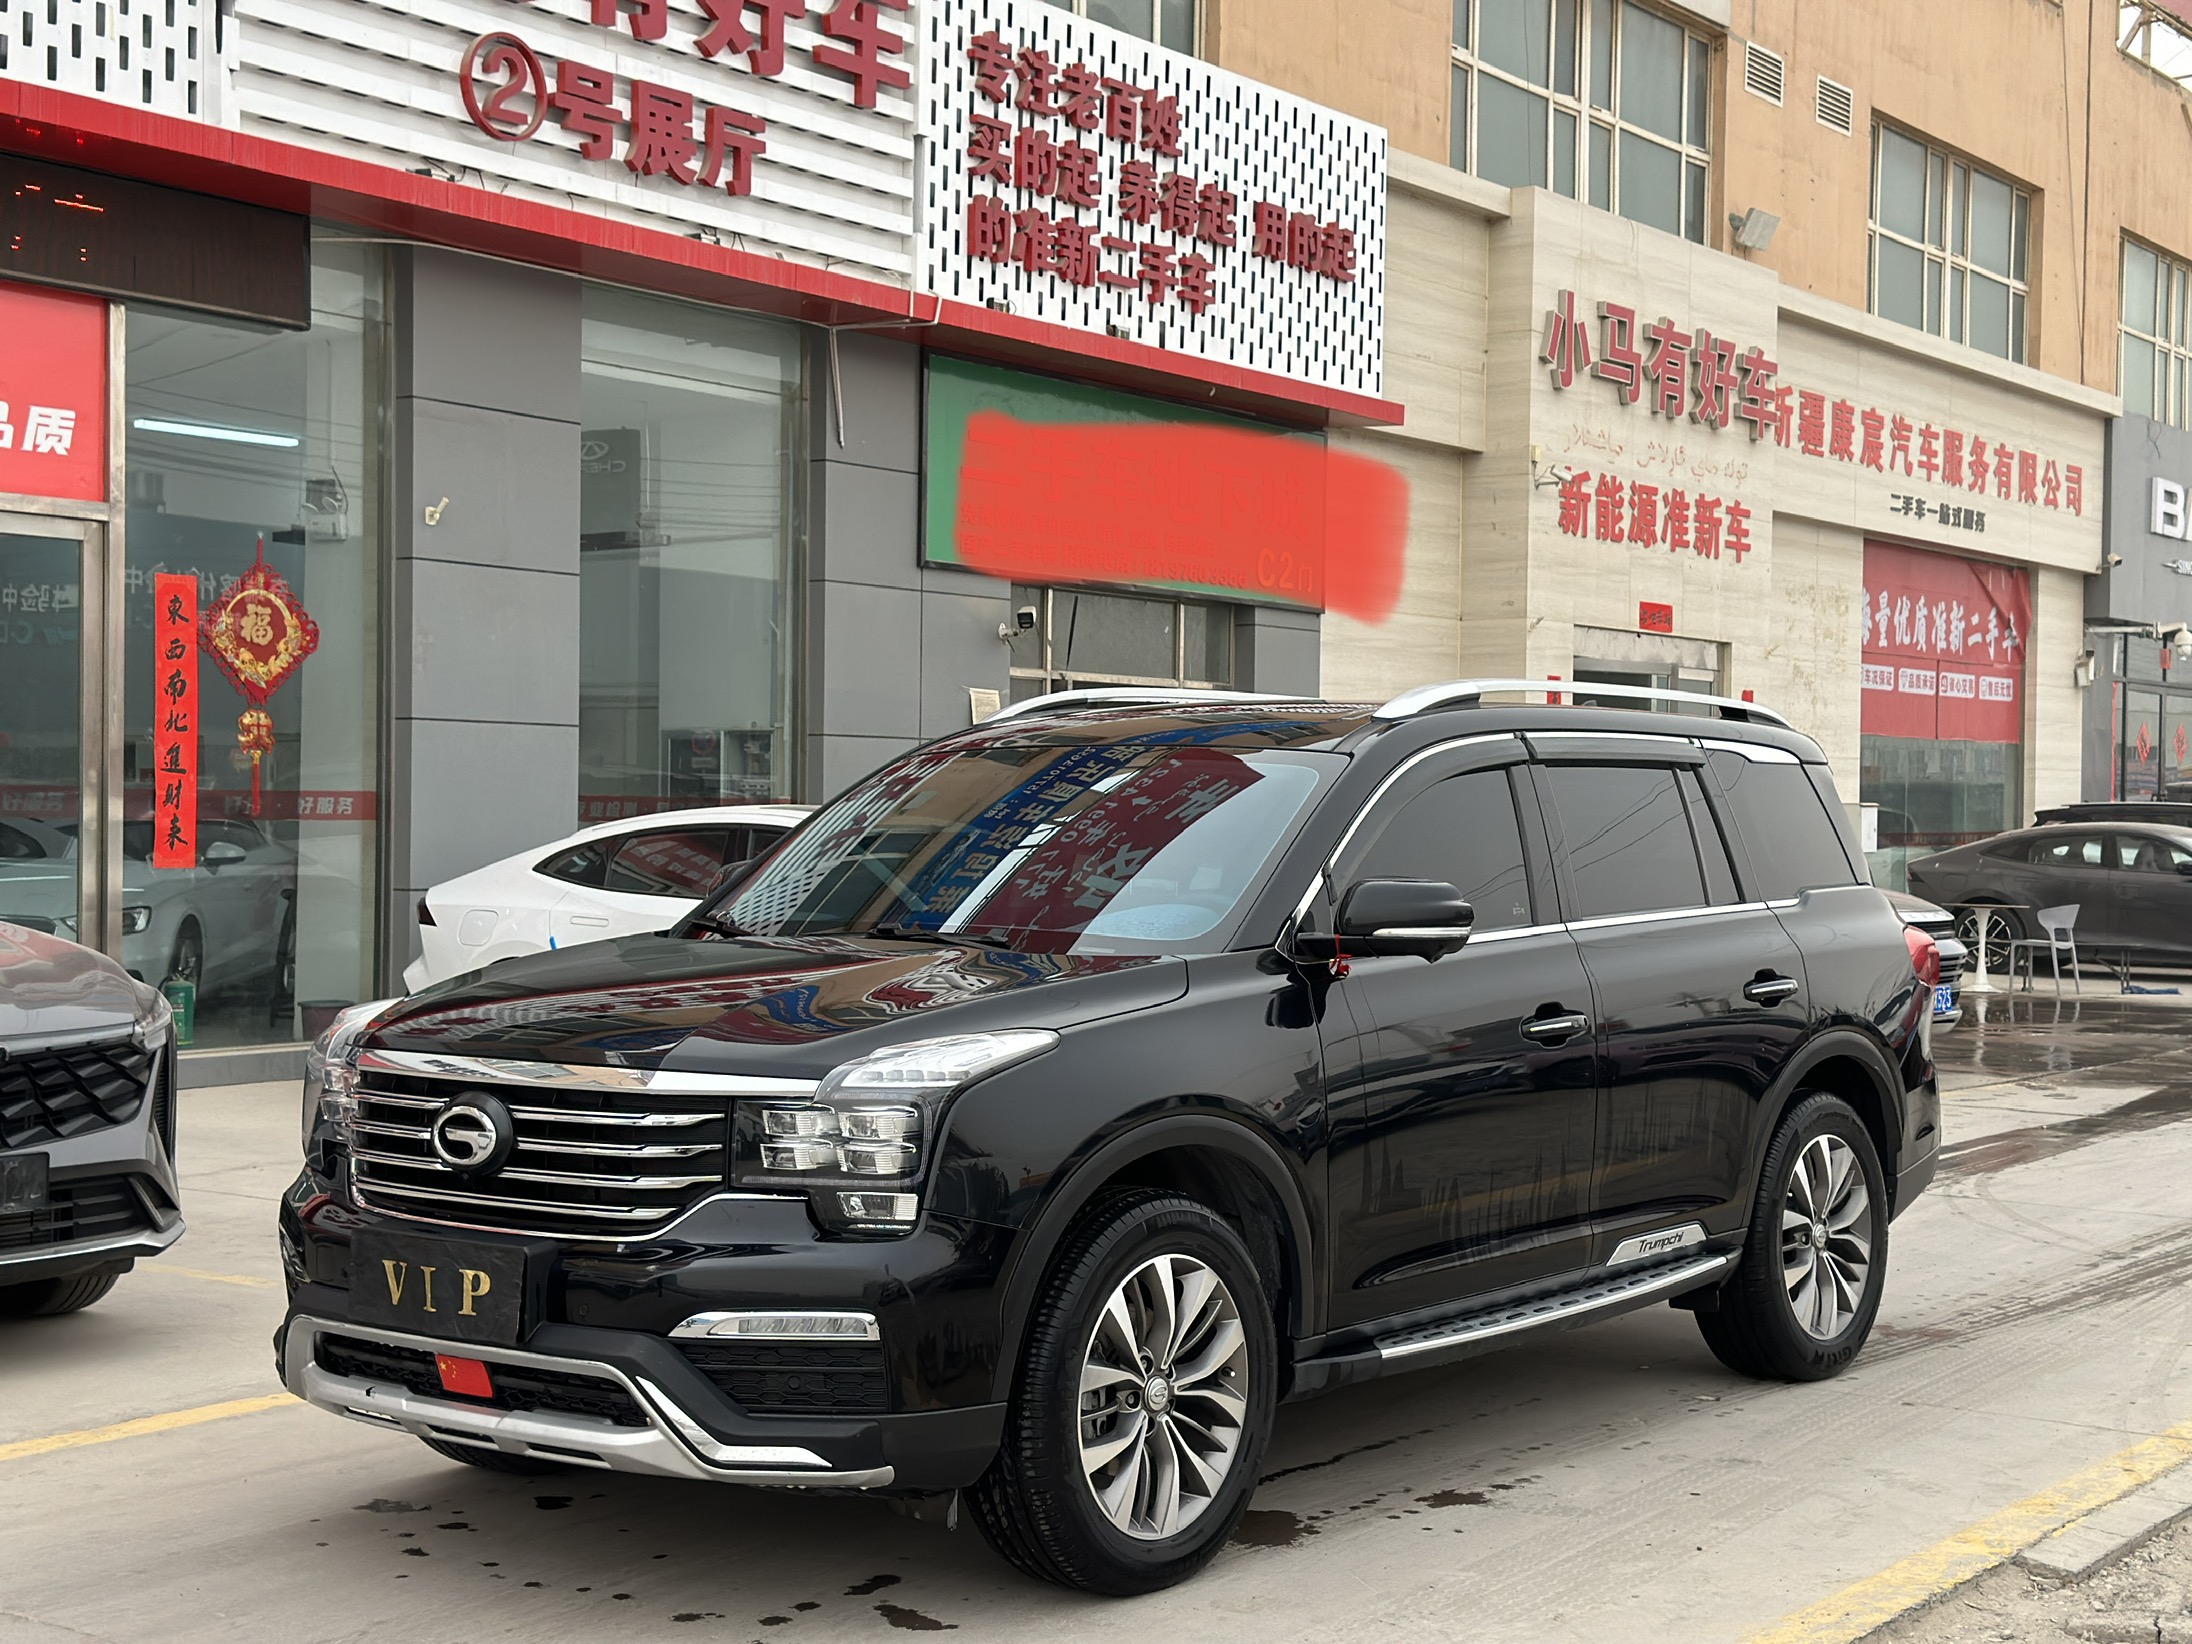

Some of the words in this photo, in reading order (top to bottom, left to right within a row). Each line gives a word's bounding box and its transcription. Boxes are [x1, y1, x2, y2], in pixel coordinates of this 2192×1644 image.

[967, 31, 1183, 158] 专注老百姓
[967, 113, 1101, 209] 买的起
[1119, 158, 1238, 248] 养得起
[1252, 201, 1356, 282] 用的起
[967, 194, 1216, 314] 的准新二手车
[1539, 288, 1778, 441] 小马有好车
[1558, 465, 1752, 563] 新能源准新车
[1890, 493, 1986, 533] 二手车一站式服务
[240, 603, 274, 646] 福
[381, 1259, 491, 1316] VIP
[1639, 1231, 1685, 1253] Trumpchi
